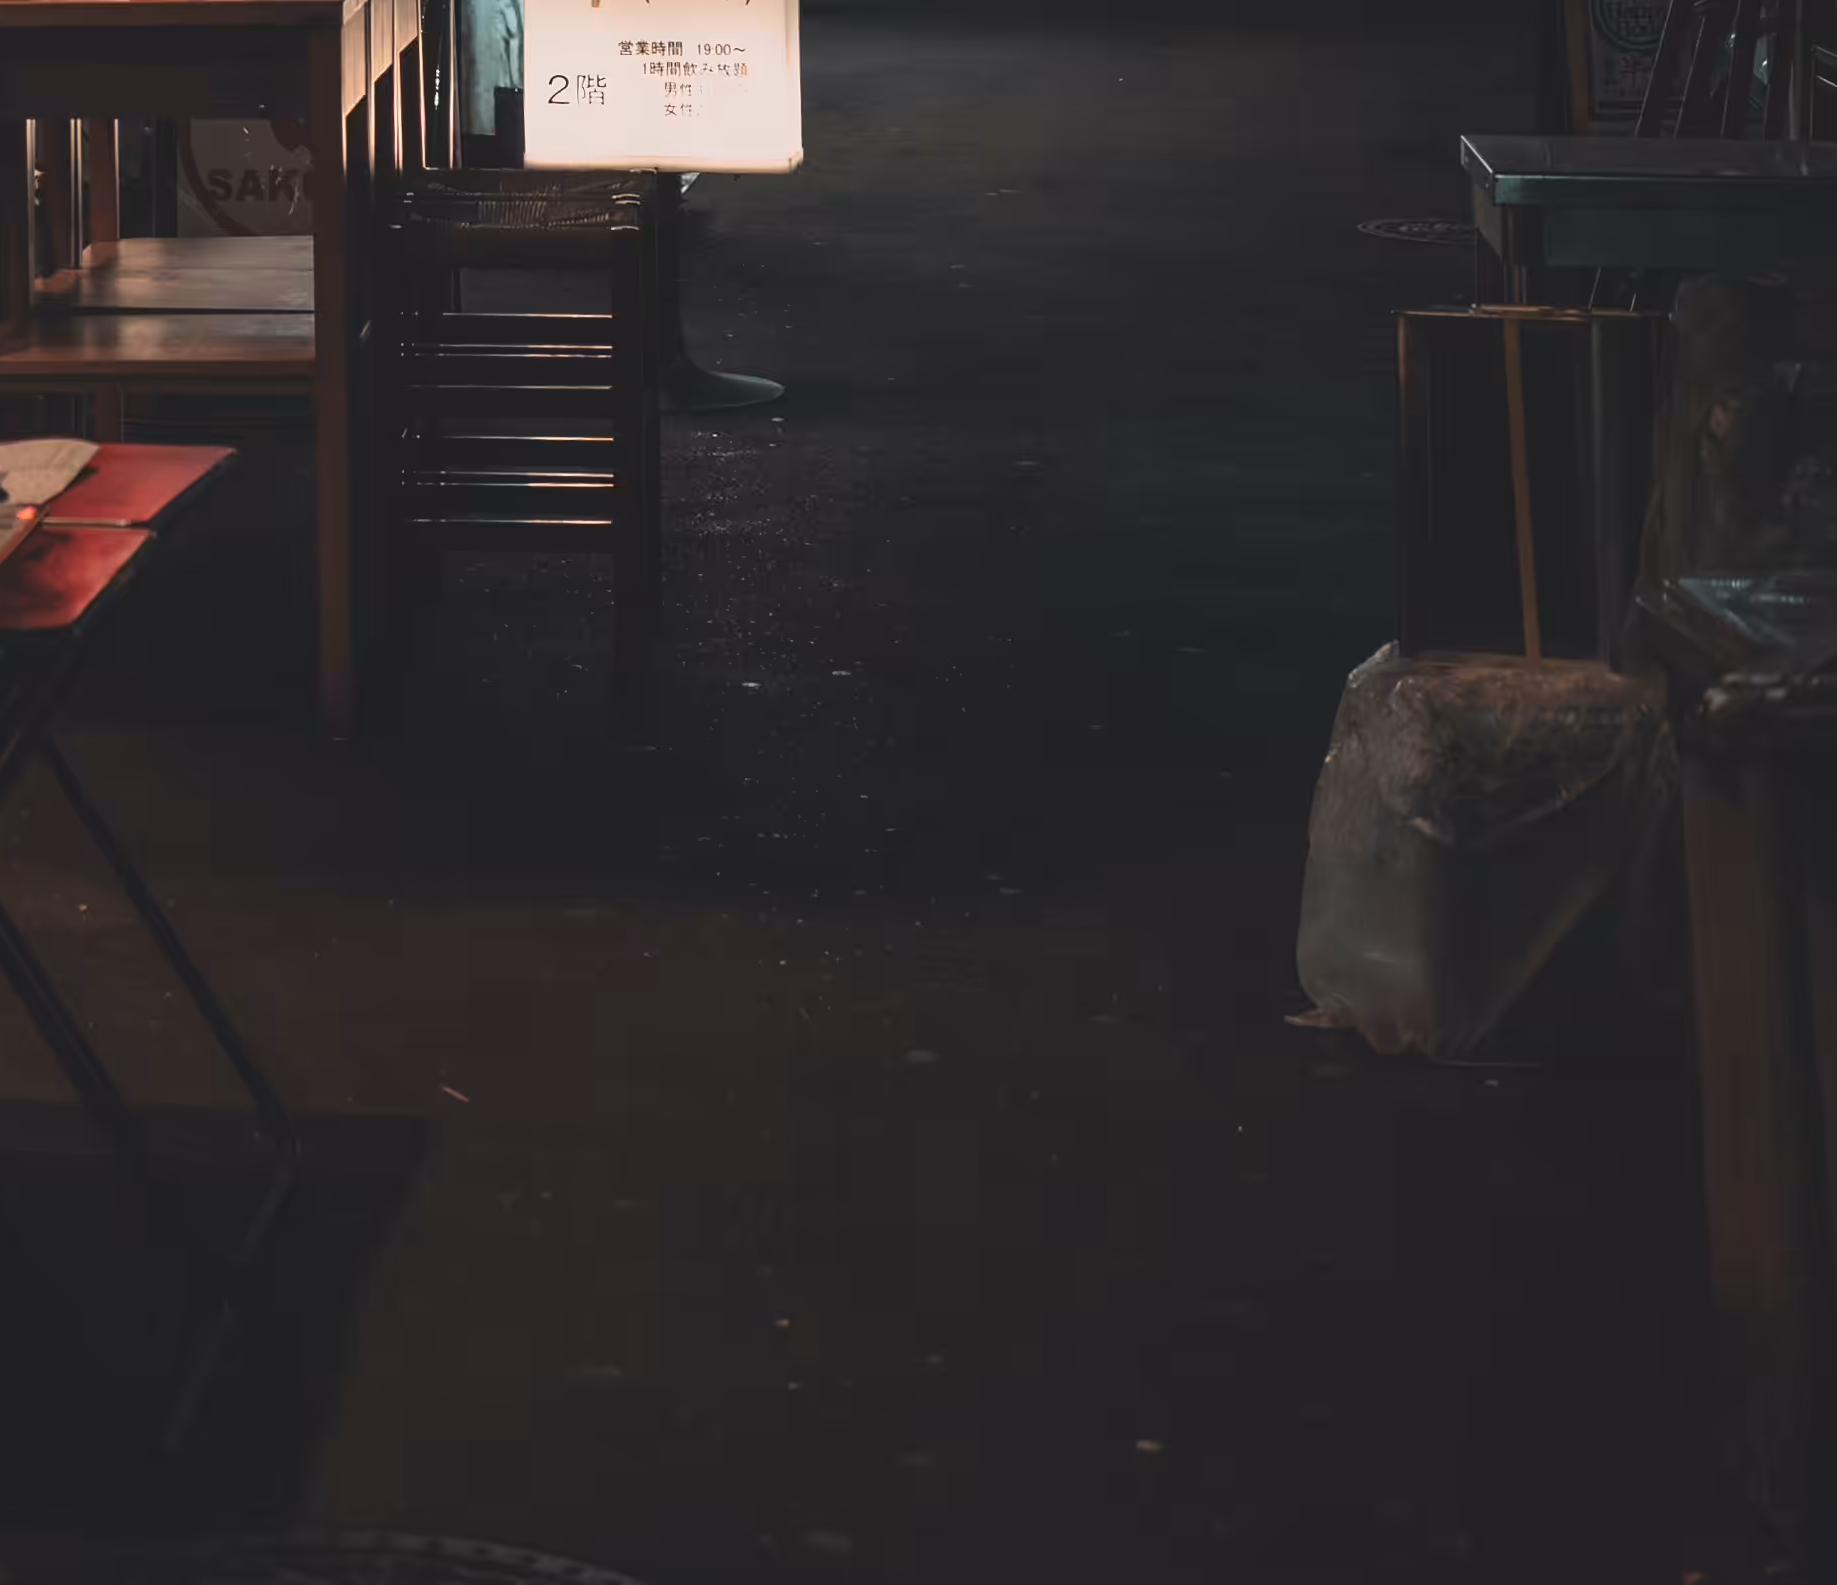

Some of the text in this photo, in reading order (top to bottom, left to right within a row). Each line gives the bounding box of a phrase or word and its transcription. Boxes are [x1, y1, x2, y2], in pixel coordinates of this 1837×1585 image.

[618, 40, 683, 57] 営業時間
[547, 73, 607, 106] 2階
